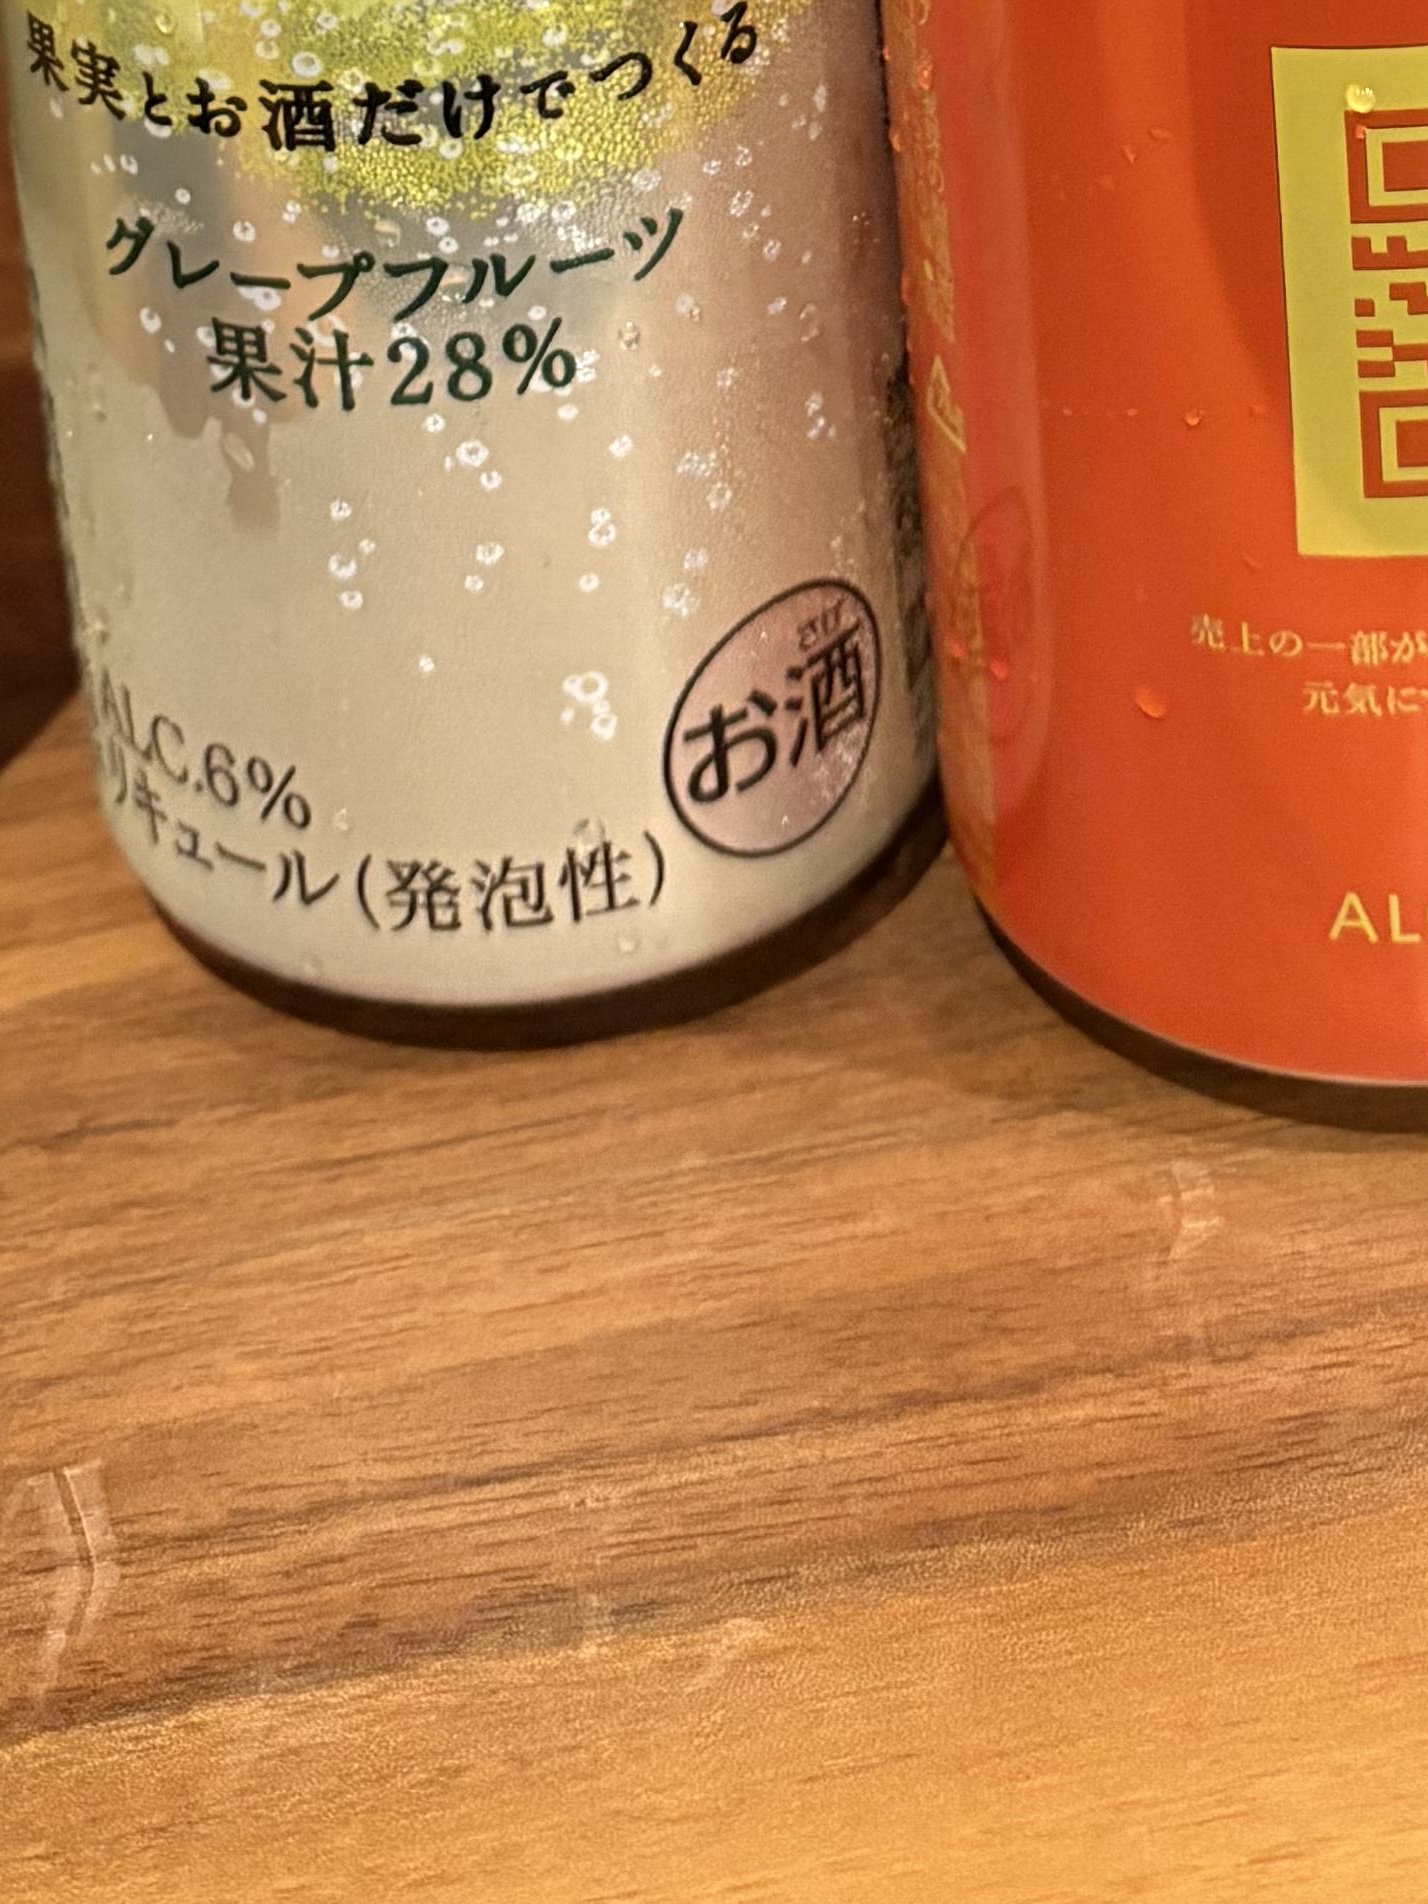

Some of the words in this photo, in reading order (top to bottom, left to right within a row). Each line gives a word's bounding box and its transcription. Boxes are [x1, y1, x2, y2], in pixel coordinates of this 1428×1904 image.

[26, 0, 760, 149] 果実とお酒だけでつくる
[104, 205, 685, 320] グレープフルーツ
[204, 317, 578, 412] 果汁28%
[682, 616, 866, 805] お酒
